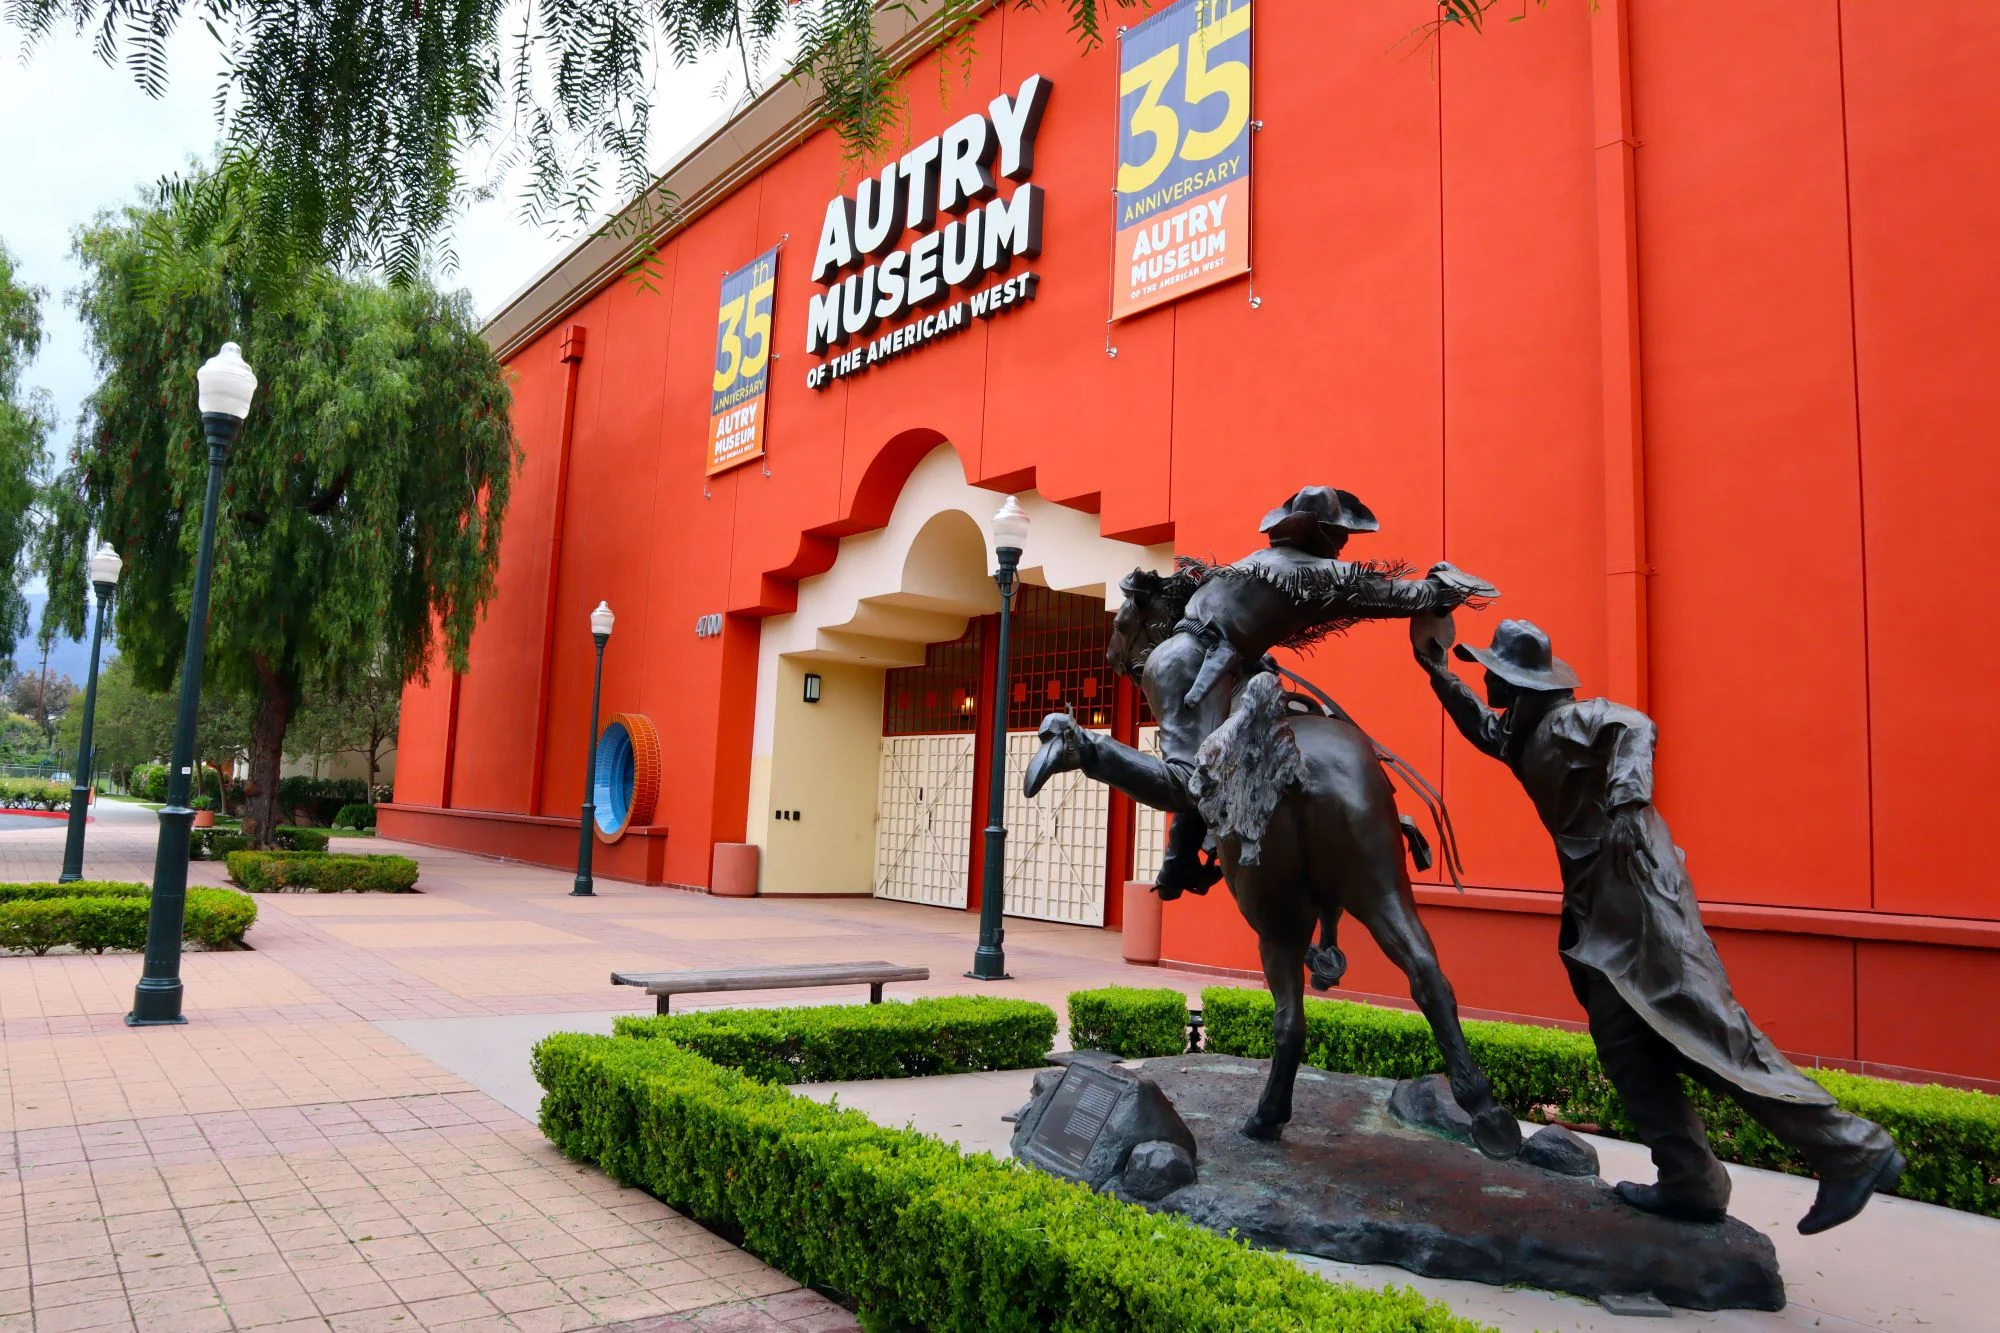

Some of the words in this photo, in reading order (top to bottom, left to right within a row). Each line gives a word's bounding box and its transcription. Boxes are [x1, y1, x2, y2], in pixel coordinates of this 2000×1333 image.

[811, 73, 1040, 282] AUTRY
[1124, 155, 1240, 223] ANNIVERSARY
[1131, 229, 1226, 287] MUSEUM
[1132, 194, 1228, 261] AUTRY
[806, 183, 1031, 354] MUSEUM
[1143, 282, 1157, 295] THE
[1160, 266, 1200, 289] AMERICAN
[1202, 257, 1225, 272] WEST
[806, 364, 826, 389] OF
[831, 348, 862, 379] THE
[866, 302, 964, 364] AMERICAN
[970, 271, 1030, 318] WEST
[714, 425, 756, 456] MUSEUM
[716, 402, 757, 438] AUTRY
